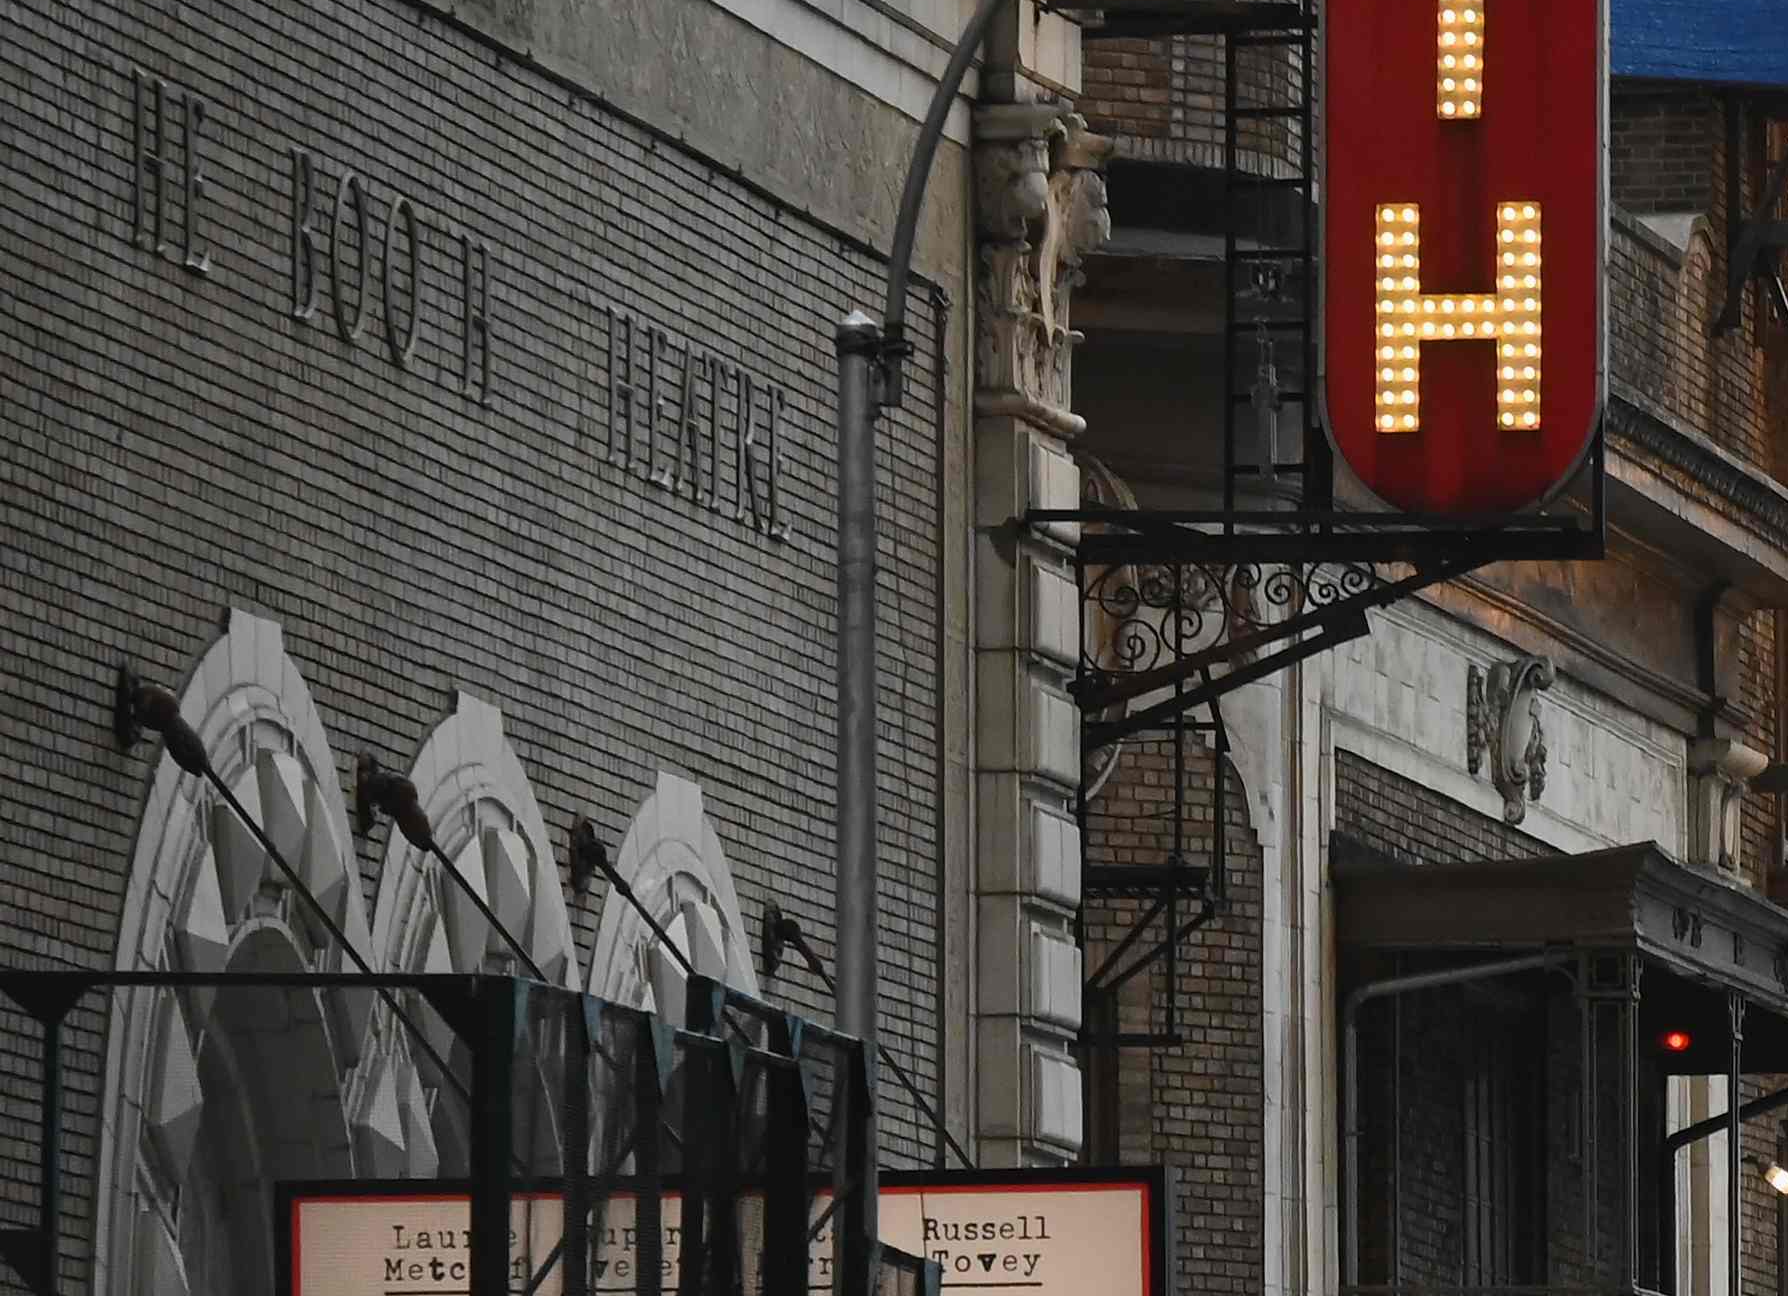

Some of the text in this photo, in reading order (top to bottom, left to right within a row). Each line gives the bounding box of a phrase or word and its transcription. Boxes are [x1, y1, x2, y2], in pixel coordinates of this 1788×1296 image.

[922, 1217, 1051, 1243] Russell
[384, 1256, 530, 1282] Metcf
[935, 1249, 1041, 1277] Tovey
